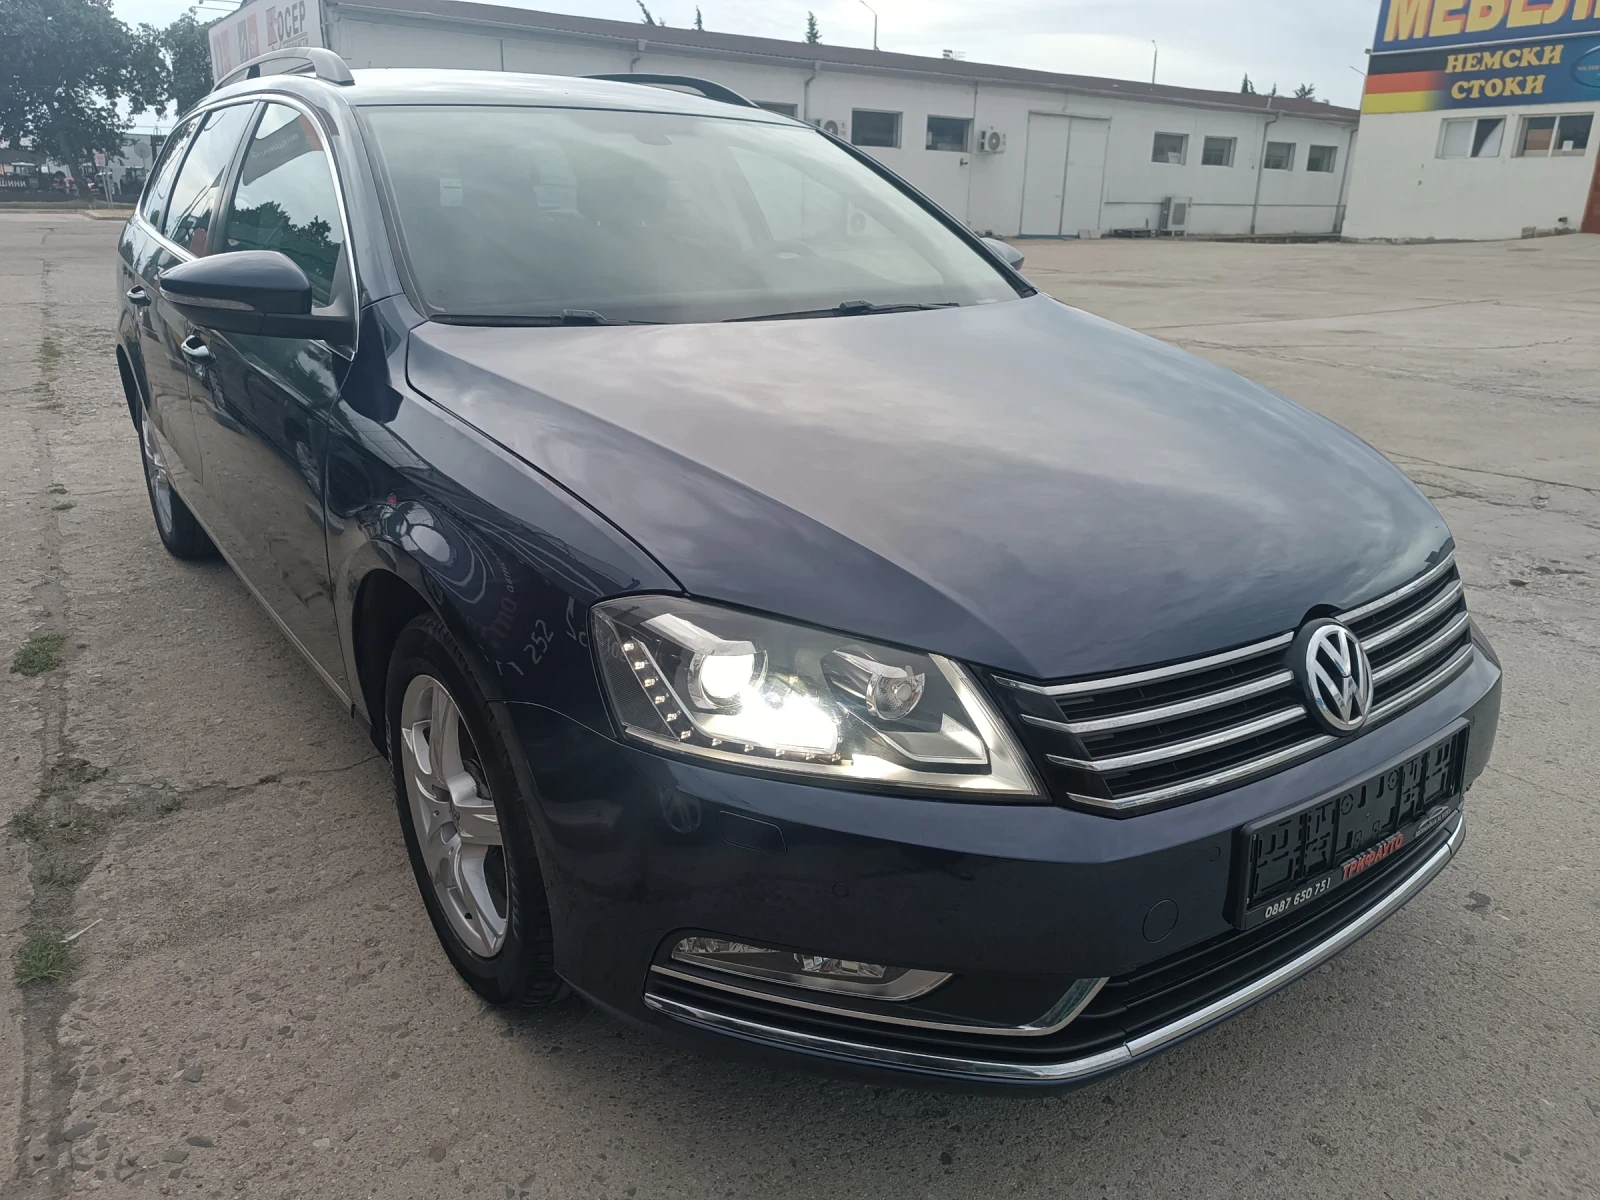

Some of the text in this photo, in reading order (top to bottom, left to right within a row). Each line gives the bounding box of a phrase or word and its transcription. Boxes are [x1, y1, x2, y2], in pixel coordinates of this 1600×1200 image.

[1444, 44, 1564, 73] НЕМСКИ
[1451, 75, 1546, 99] СТОКИ
[1341, 835, 1404, 881] ТРИФАУТО
[1265, 877, 1331, 918] 0887 650 751
